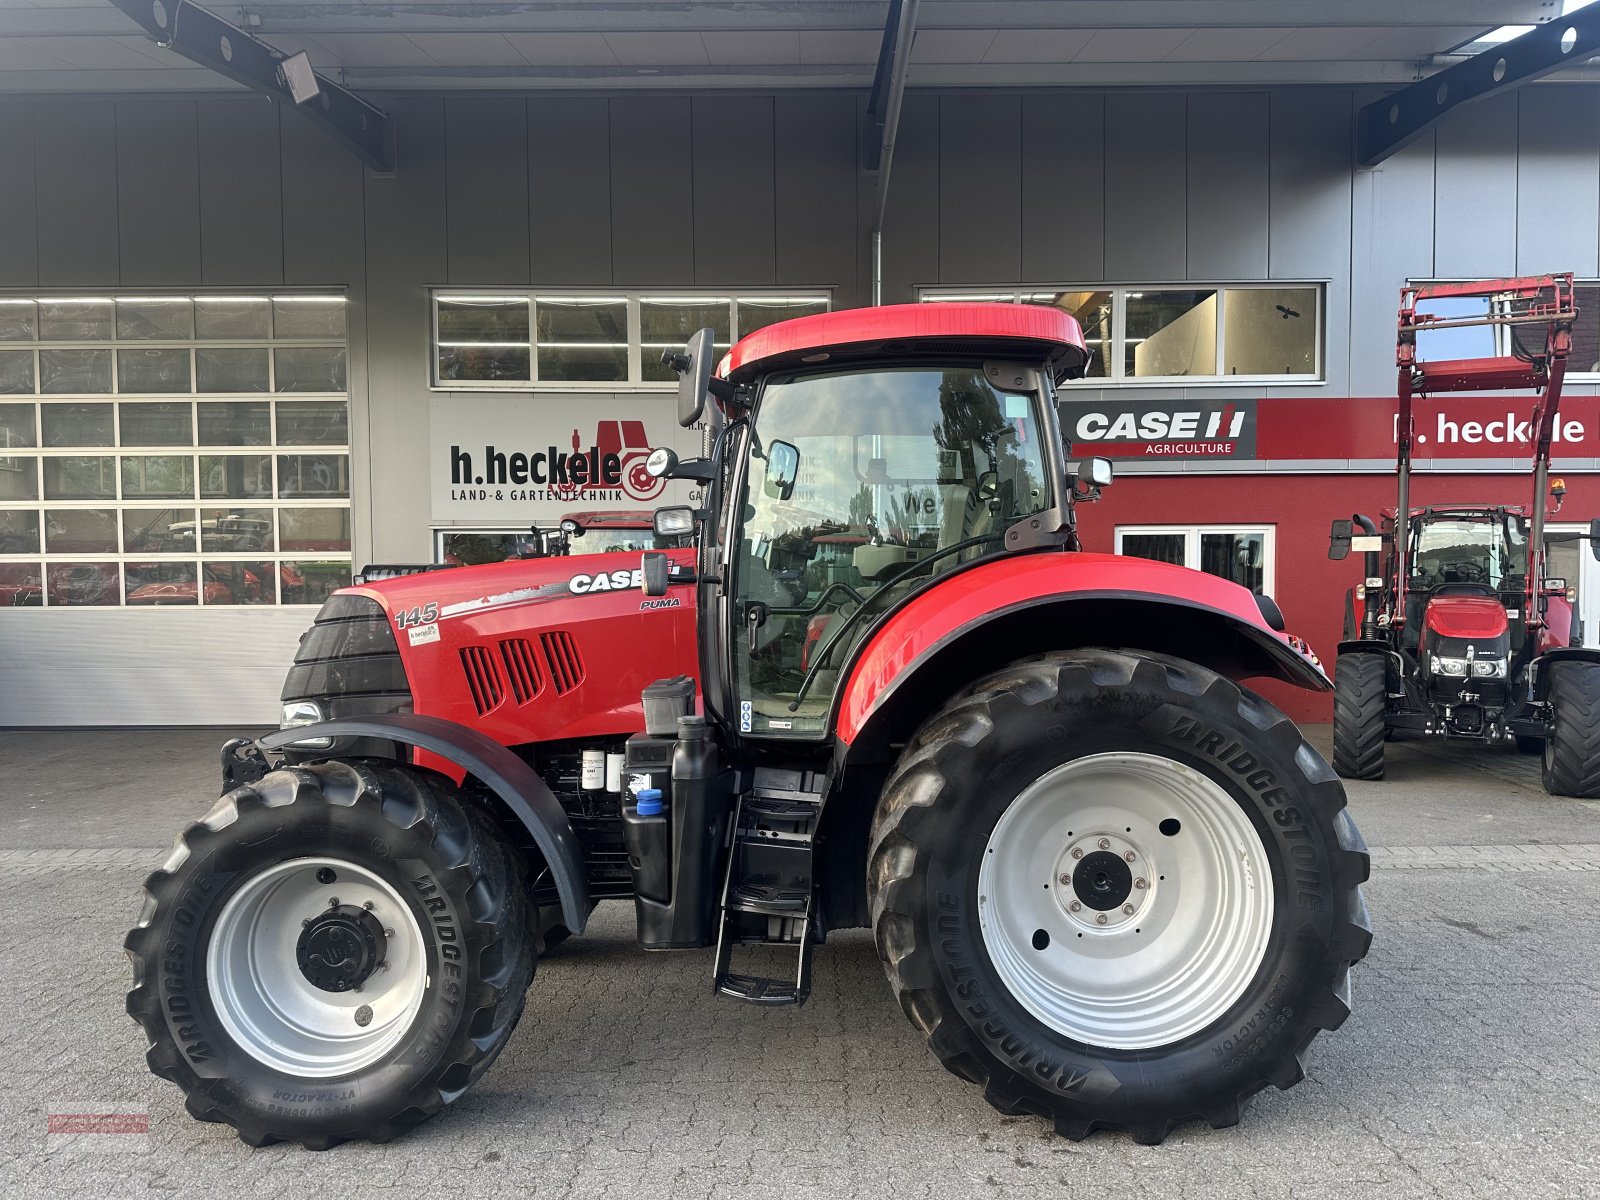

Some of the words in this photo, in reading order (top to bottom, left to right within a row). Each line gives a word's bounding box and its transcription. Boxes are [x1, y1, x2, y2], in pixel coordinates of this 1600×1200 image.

[1076, 411, 1201, 440] CASE
[1437, 412, 1585, 443] heckle
[1145, 443, 1231, 453] AGRICULTURE
[450, 445, 622, 485] h.heckele
[510, 490, 622, 501] GARTENTECHNIK
[394, 602, 438, 630] 145
[640, 599, 680, 610] PUMA
[1168, 715, 1325, 912] BRIDGESTONE
[164, 873, 217, 1064] BRIDGESTONE
[410, 875, 462, 1065] BRIDGESTONE
[936, 891, 1093, 1093] BRIDGESTONE
[272, 1089, 356, 1102] VT-TRACTOR
